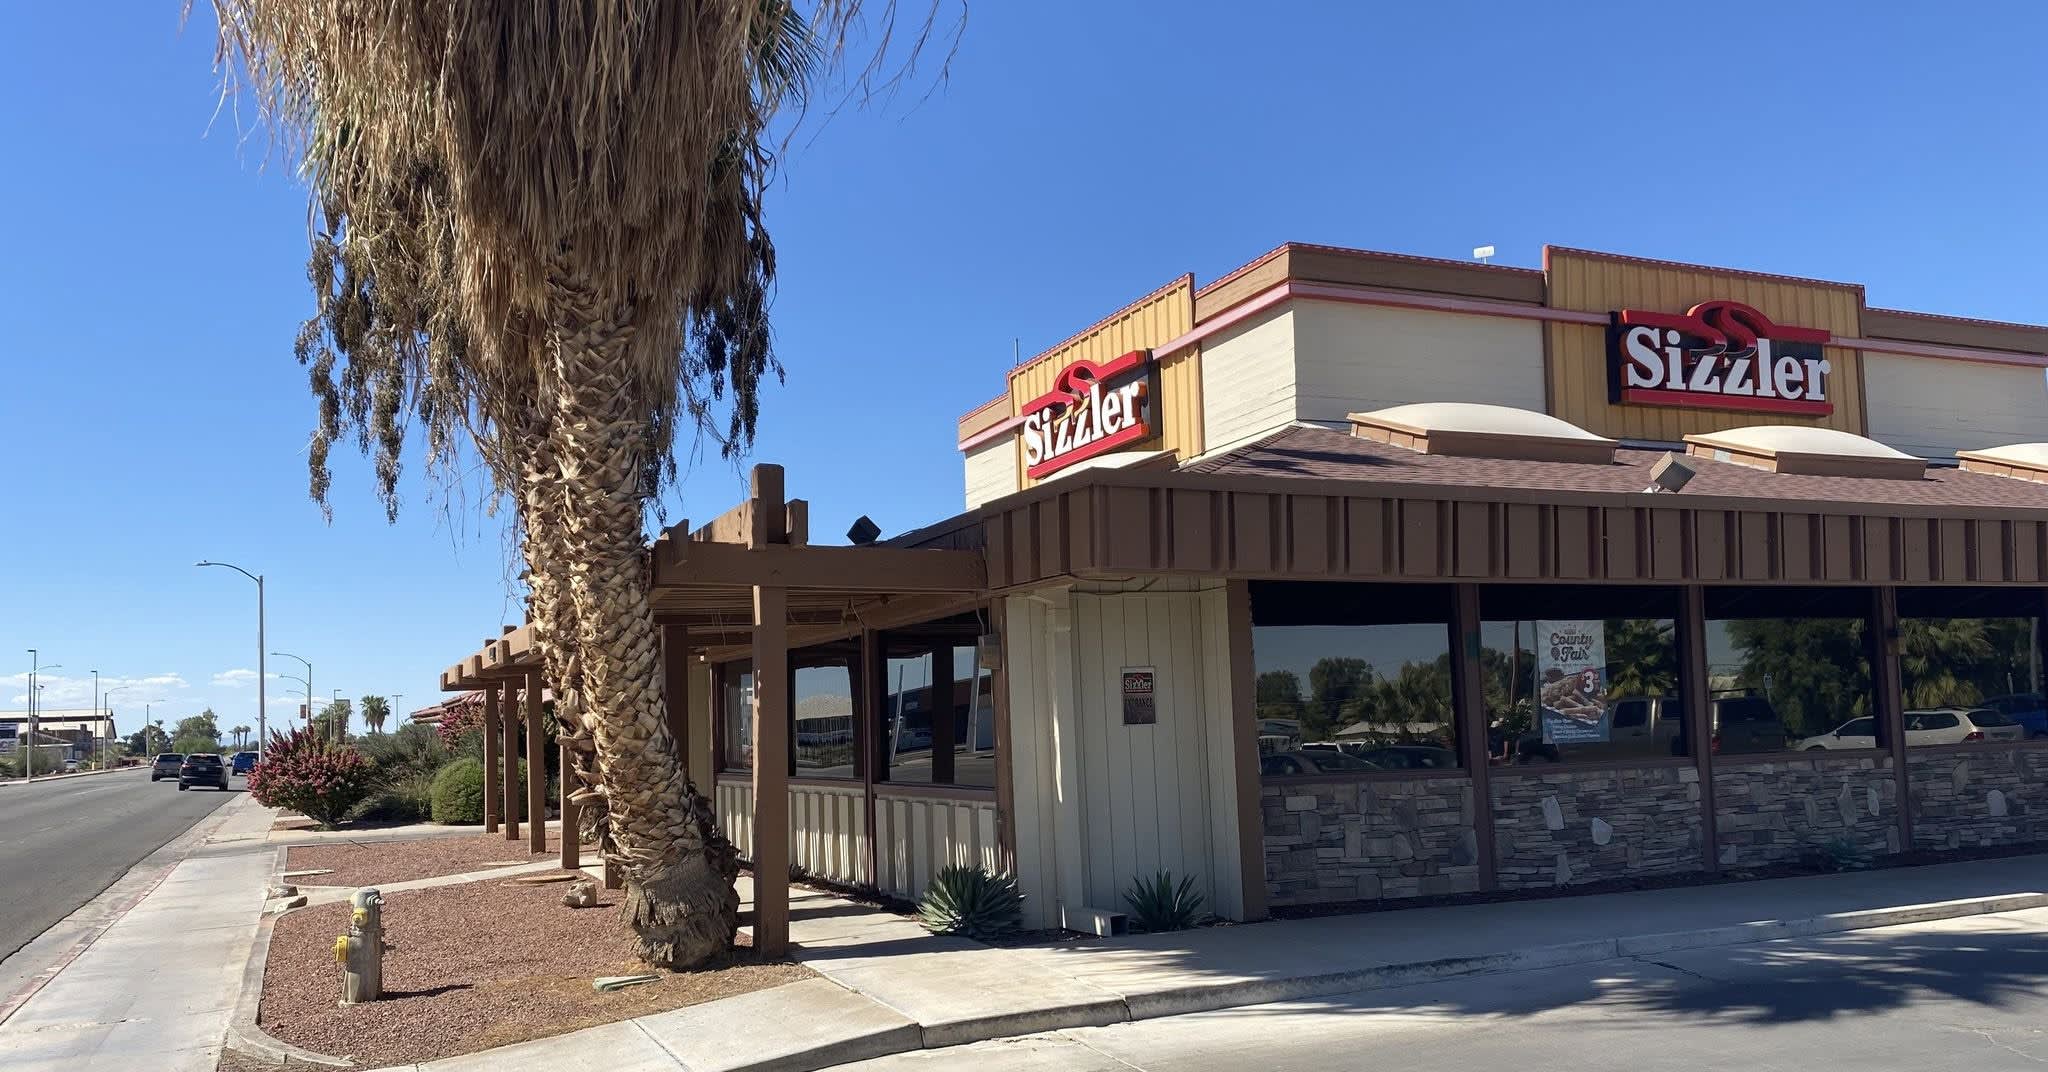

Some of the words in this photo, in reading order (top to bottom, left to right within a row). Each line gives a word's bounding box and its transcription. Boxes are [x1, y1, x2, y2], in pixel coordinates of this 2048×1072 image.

[1626, 326, 1831, 400] Sizzler
[1023, 381, 1140, 467] Sizzler
[1550, 633, 1594, 650] County
[1560, 646, 1590, 662] Fair
[1124, 679, 1152, 690] Sizzler
